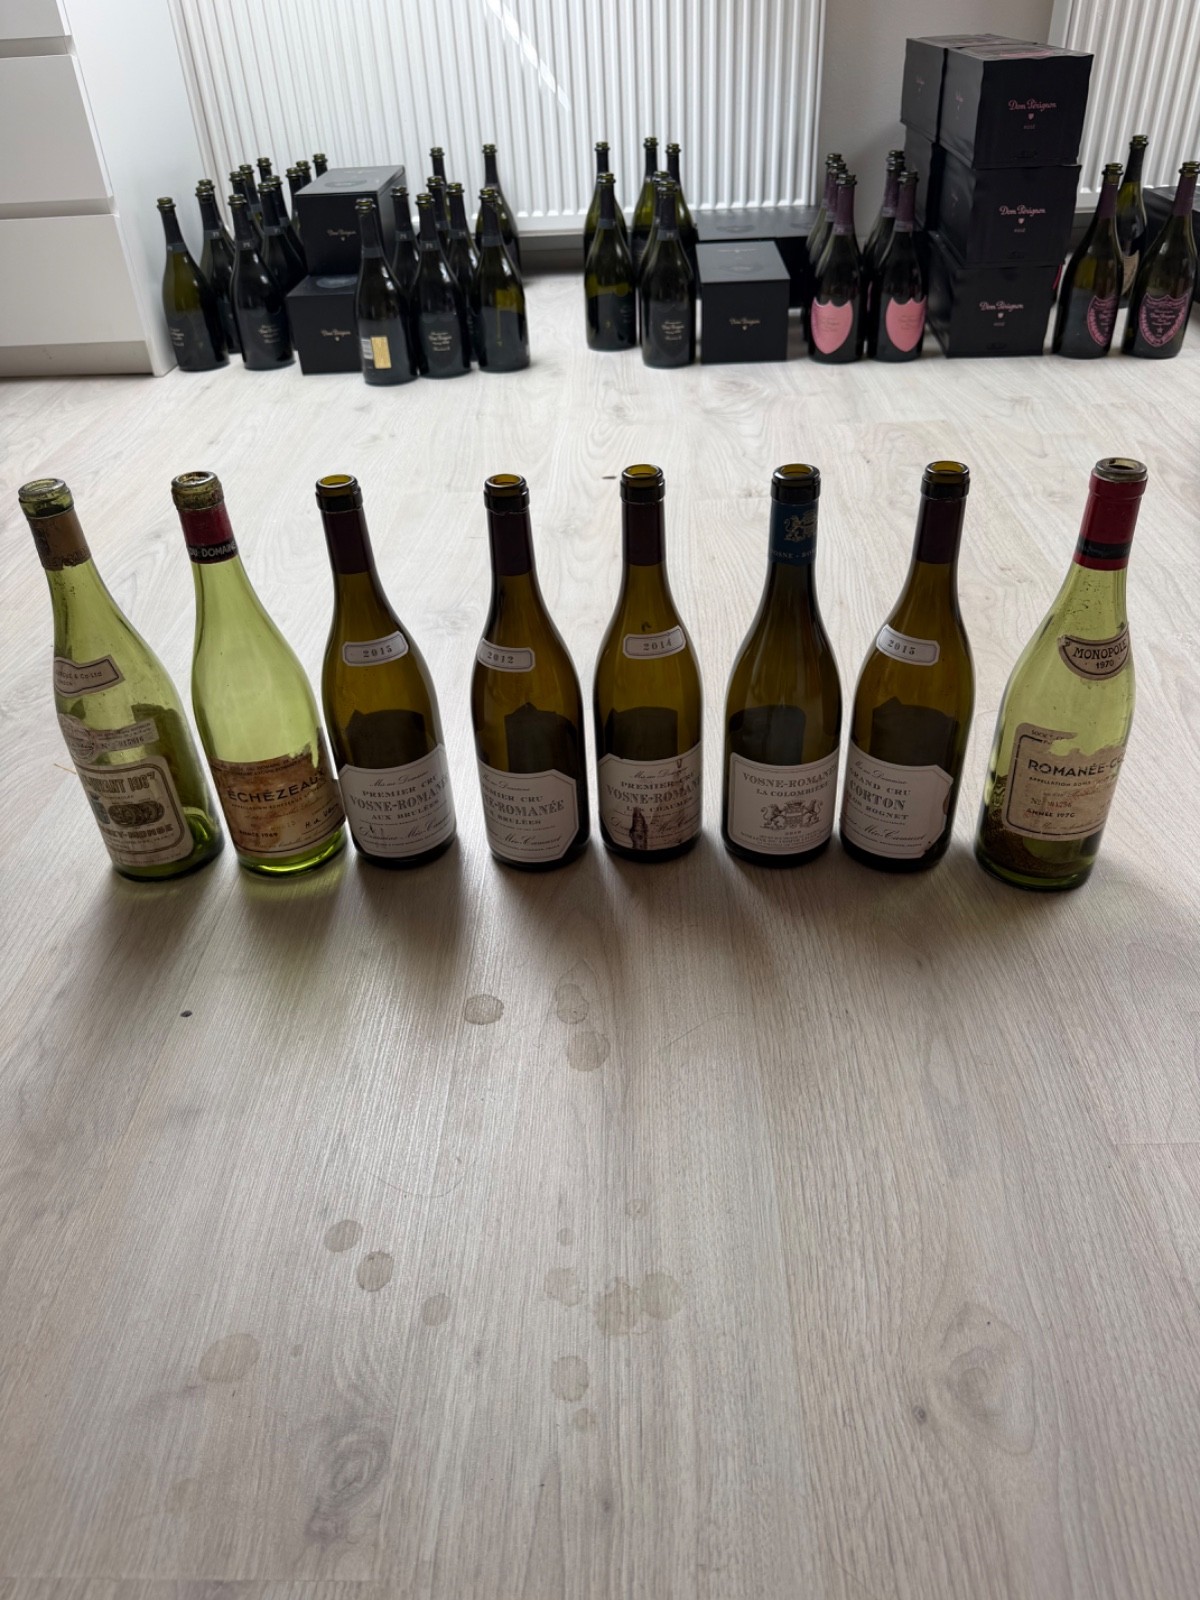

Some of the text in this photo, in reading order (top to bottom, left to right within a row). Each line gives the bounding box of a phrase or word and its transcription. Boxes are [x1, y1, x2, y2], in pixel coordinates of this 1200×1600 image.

[1008, 99, 1026, 111] Dom
[999, 205, 1017, 216] Dom
[979, 301, 996, 311] Dom
[362, 644, 393, 658] 2015
[643, 639, 671, 651] 2014
[888, 639, 916, 656] 2015
[487, 651, 514, 664] 2012
[1096, 661, 1115, 669] 1970
[226, 767, 325, 803] ÉCHÉZEAUX
[621, 781, 676, 791] PREMIER
[362, 786, 416, 798] PREMIER
[757, 788, 768, 796] LA
[849, 780, 906, 811] CORTON
[886, 787, 911, 796] CRU
[865, 804, 909, 820] ROGNET
